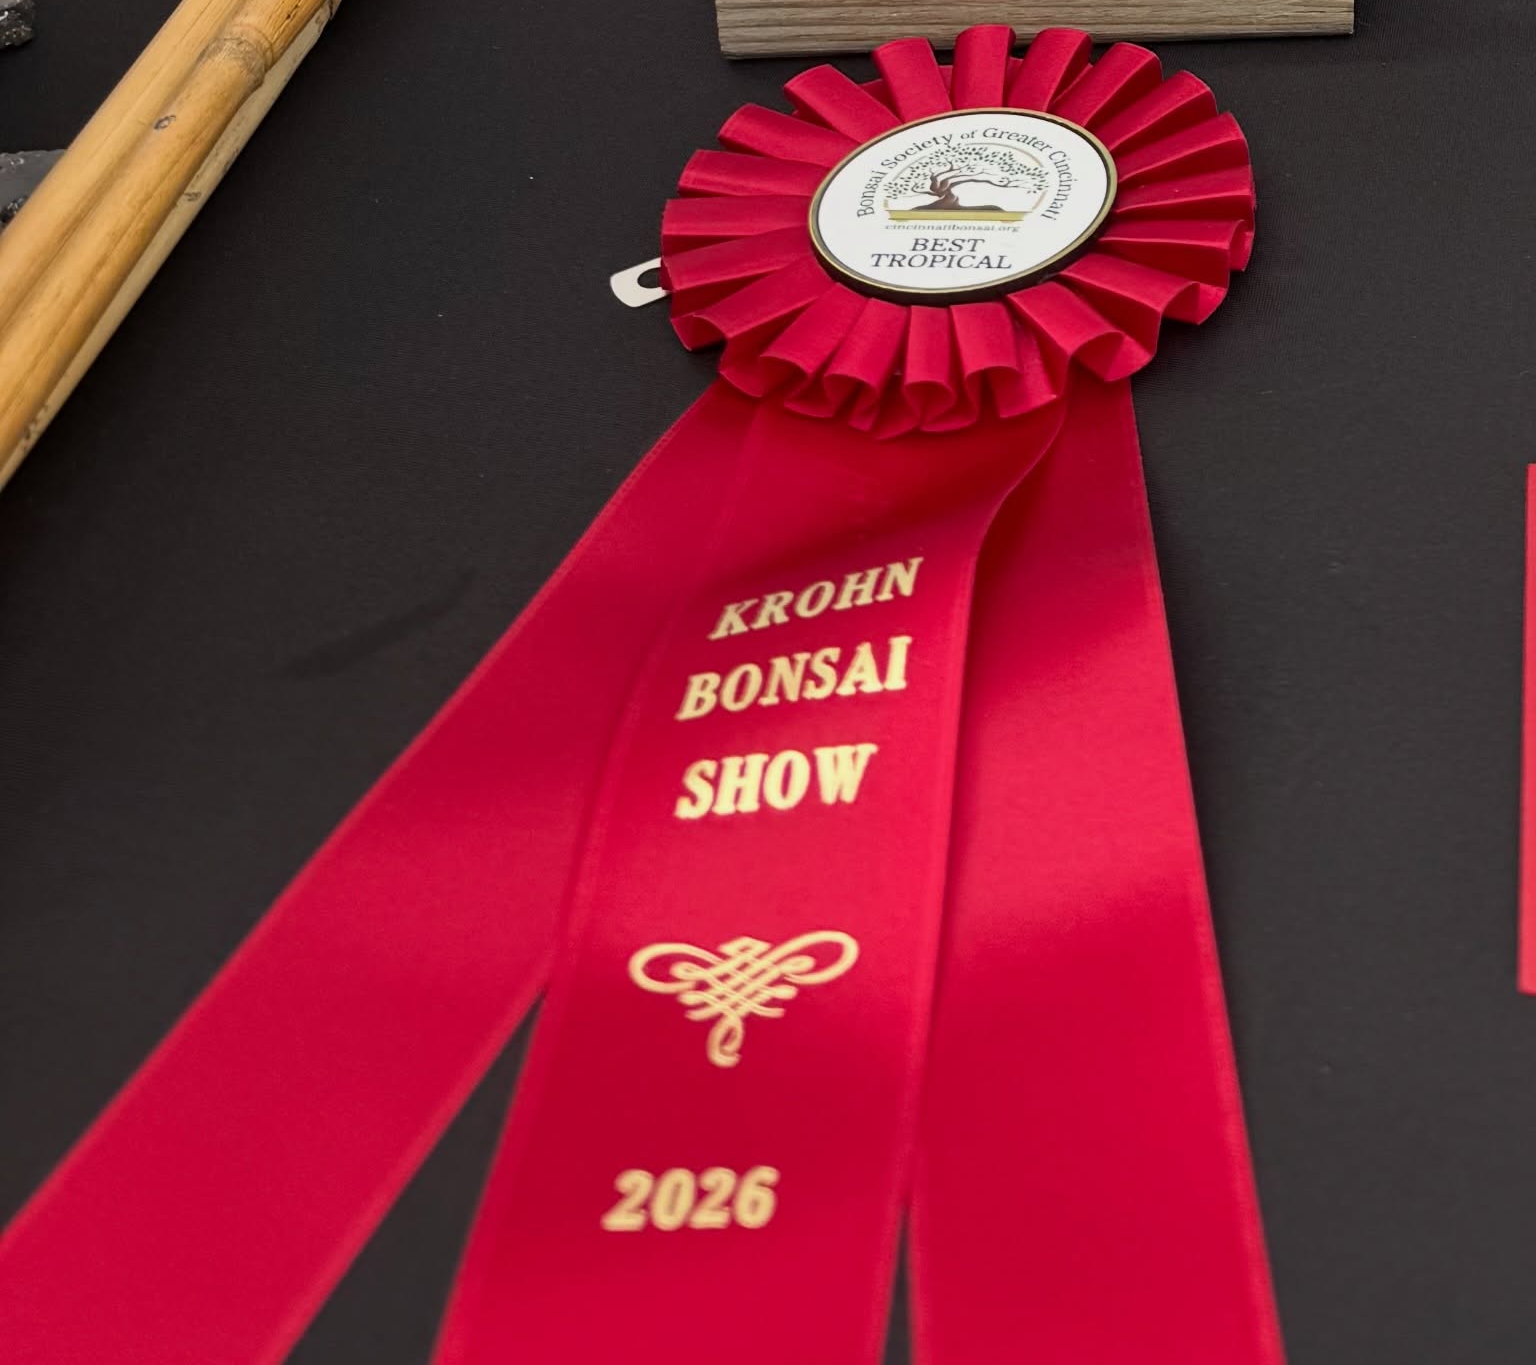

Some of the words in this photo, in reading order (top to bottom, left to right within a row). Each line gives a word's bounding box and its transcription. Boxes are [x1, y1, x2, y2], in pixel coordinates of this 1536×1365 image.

[857, 170, 887, 218] Bonsai
[881, 132, 953, 169] Society
[960, 130, 978, 140] of
[982, 127, 1053, 153] Greater
[1041, 150, 1078, 221] Cincinnati
[870, 253, 1012, 269] TROPICAL
[910, 238, 985, 252] BEST
[708, 556, 924, 640] KROHN
[675, 635, 913, 720] BONSAI
[675, 742, 879, 820] SHOW
[601, 1166, 780, 1232] 2026
